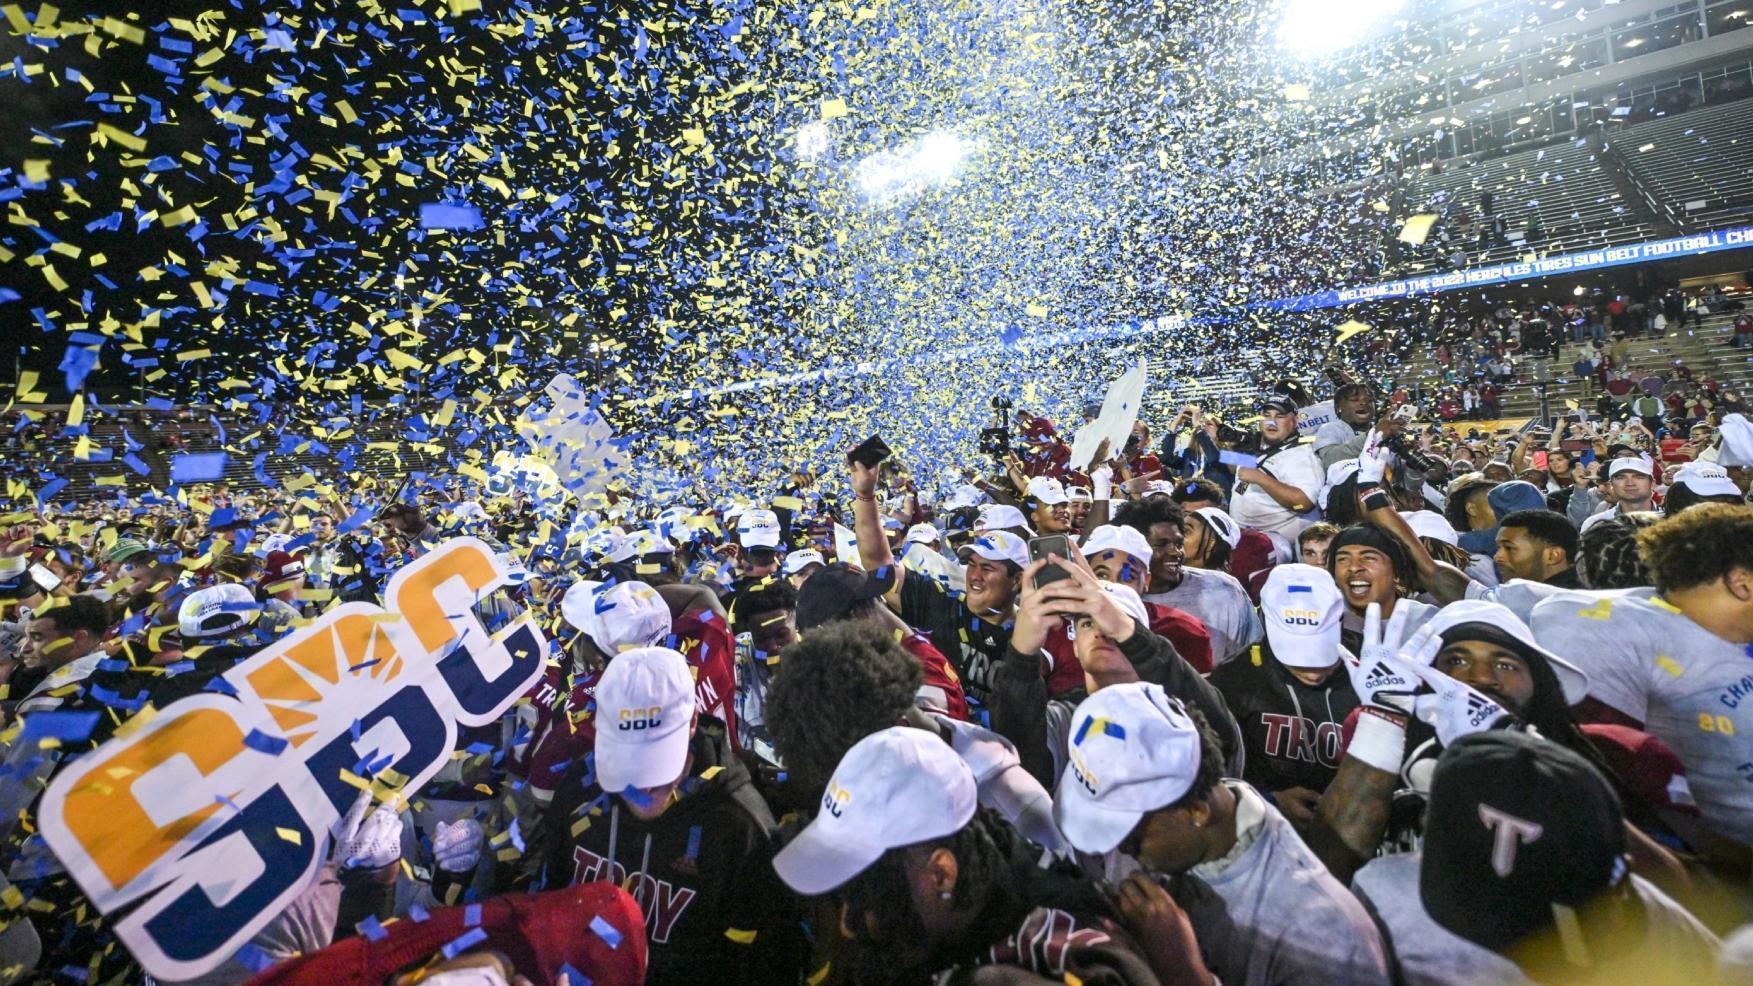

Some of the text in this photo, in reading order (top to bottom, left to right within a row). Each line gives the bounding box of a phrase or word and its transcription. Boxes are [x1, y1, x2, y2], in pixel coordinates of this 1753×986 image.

[1338, 286, 1389, 302] WELCOME
[1405, 280, 1430, 293] THE
[1432, 276, 1463, 288] 2022
[1533, 256, 1573, 273] TIRES
[1573, 252, 1605, 267] SUN
[1607, 246, 1642, 261] BELT
[1644, 234, 1723, 256] FOOTBALL
[1309, 414, 1332, 427] BELT
[1284, 609, 1319, 626] SBC
[1365, 677, 1405, 689] adidas
[618, 706, 662, 731] SBC
[62, 546, 542, 961] SBC
[1478, 803, 1544, 878] T
